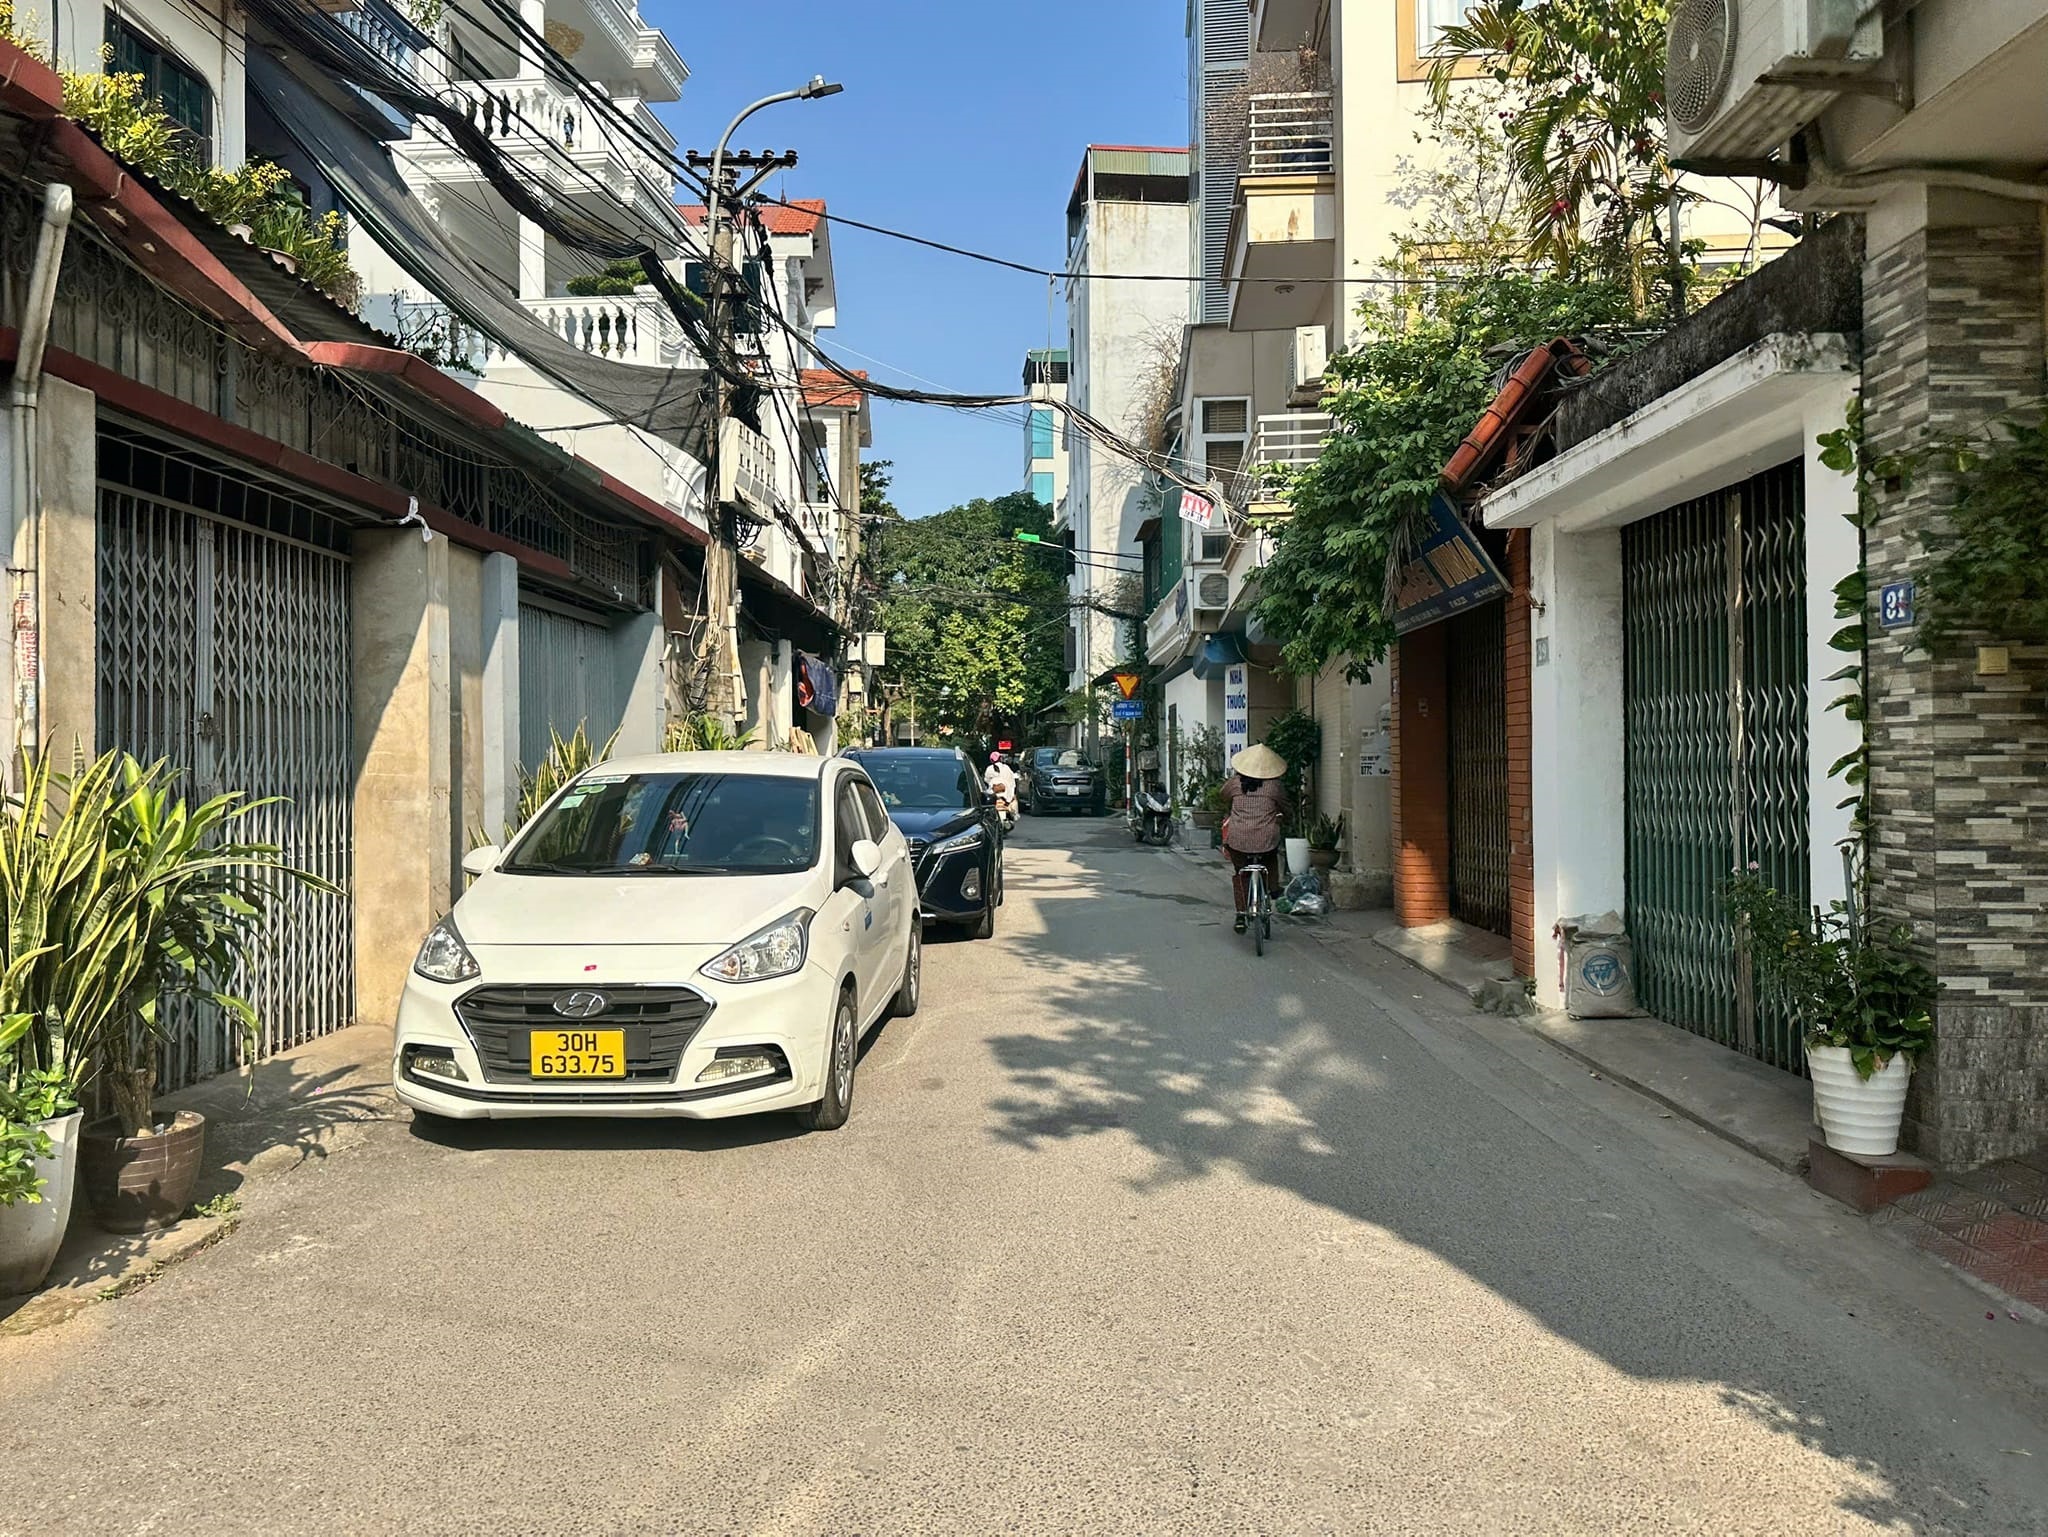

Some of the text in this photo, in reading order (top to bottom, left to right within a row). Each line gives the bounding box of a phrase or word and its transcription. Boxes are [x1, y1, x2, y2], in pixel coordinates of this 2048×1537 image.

[1182, 495, 1213, 519] TIVI
[1886, 588, 1905, 620] 31
[1227, 719, 1246, 734] THANH
[557, 1033, 597, 1052] 30H
[541, 1055, 614, 1074] 633.75
